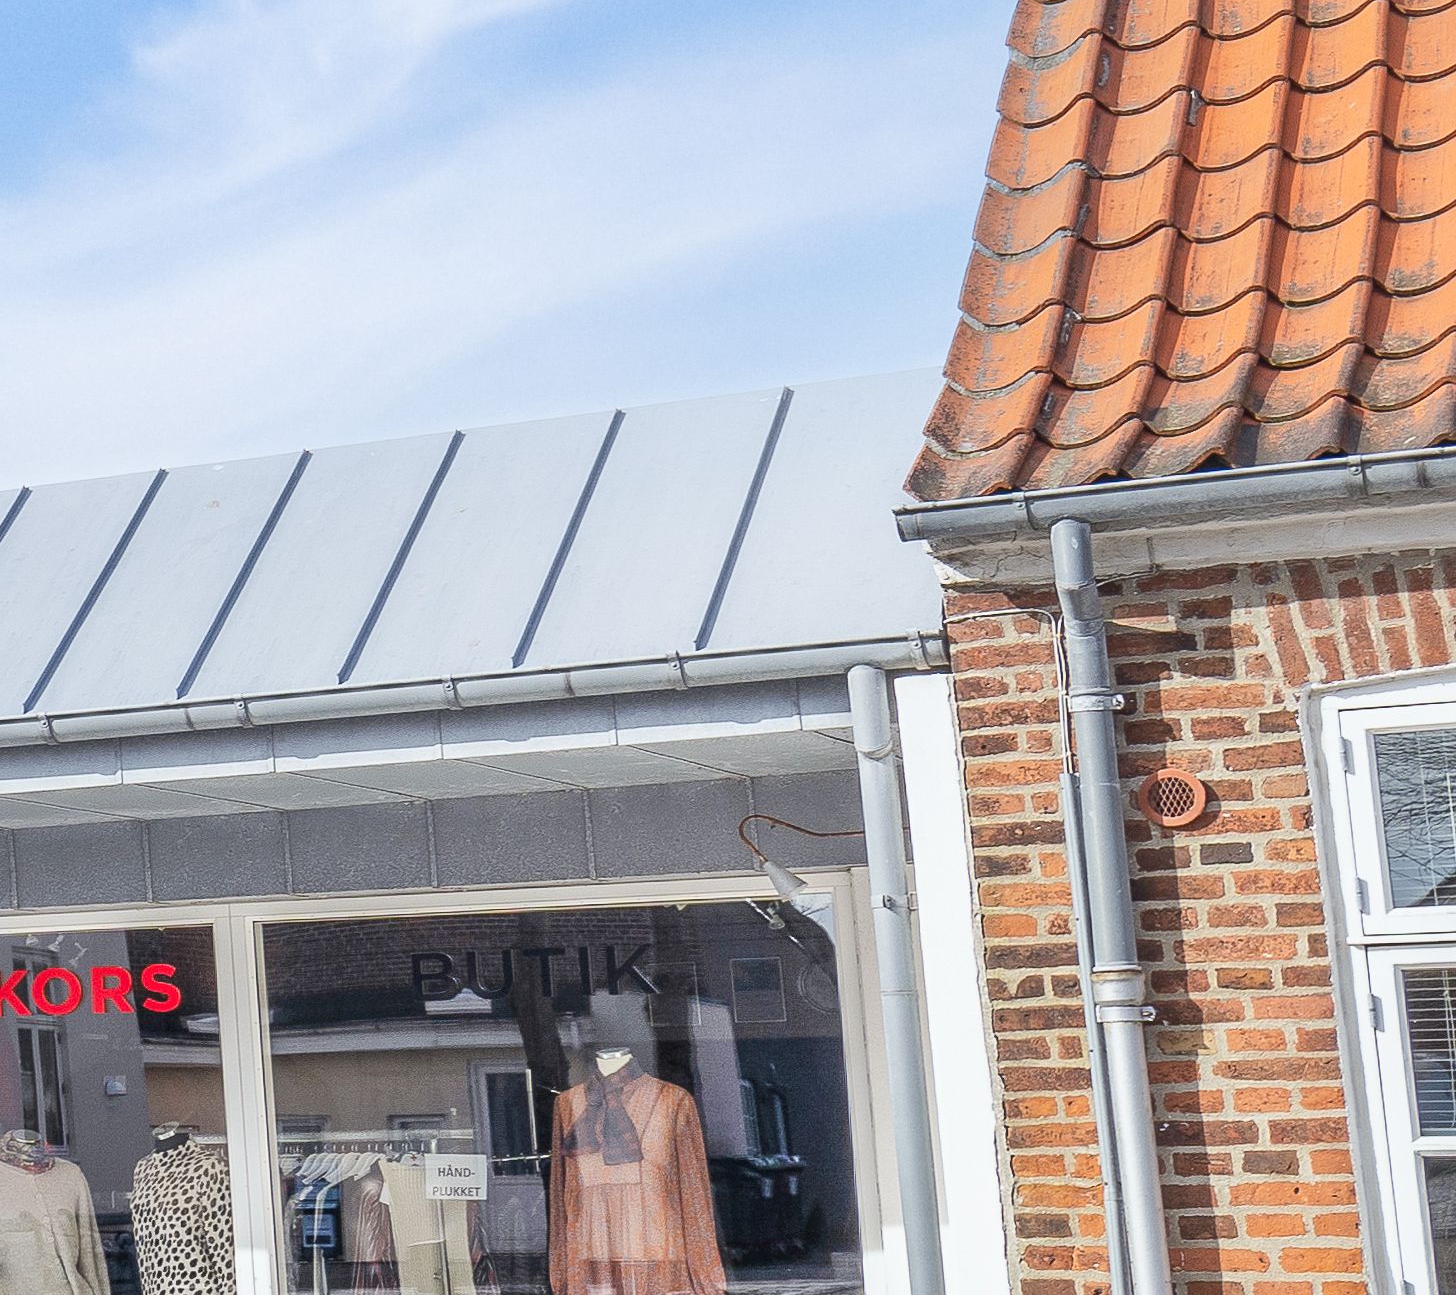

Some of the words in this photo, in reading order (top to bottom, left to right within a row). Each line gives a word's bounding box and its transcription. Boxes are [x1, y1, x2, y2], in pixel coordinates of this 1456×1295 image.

[411, 942, 660, 1000] BUTIK
[437, 1164, 476, 1178] HÅND-
[432, 1186, 482, 1197] PLUKKET
